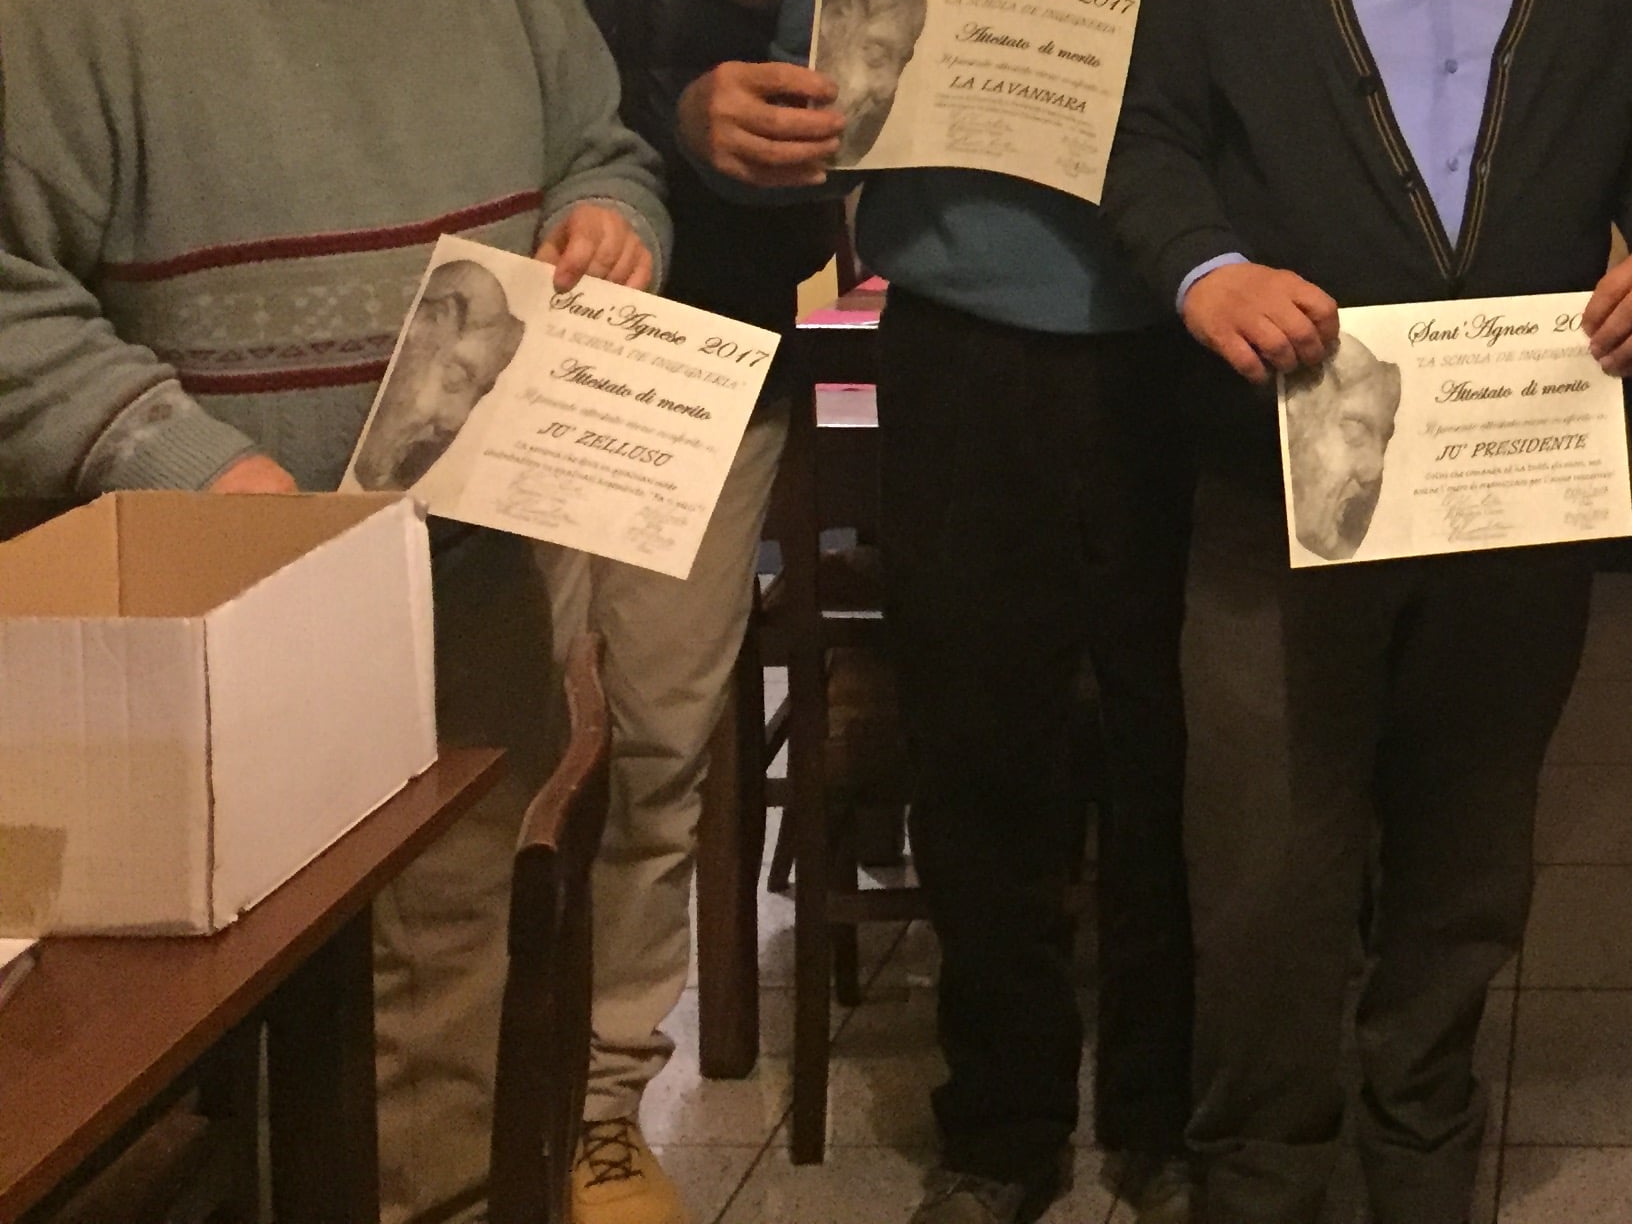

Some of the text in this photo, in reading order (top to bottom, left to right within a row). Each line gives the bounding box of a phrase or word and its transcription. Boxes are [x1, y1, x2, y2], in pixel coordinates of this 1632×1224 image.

[955, 24, 1100, 68] Attestato di merito
[949, 76, 1086, 113] LA LAVANNARA
[549, 290, 769, 367] Sant'Agnese 2017
[1408, 314, 1584, 347] Sant'Agnese 20
[550, 358, 711, 420] Attestato di merito
[1435, 380, 1590, 403] Attestato di merito
[536, 422, 576, 438] JU'
[574, 430, 674, 467] ZELLUSU
[1435, 433, 1588, 461] JU' PRESIDENTE
